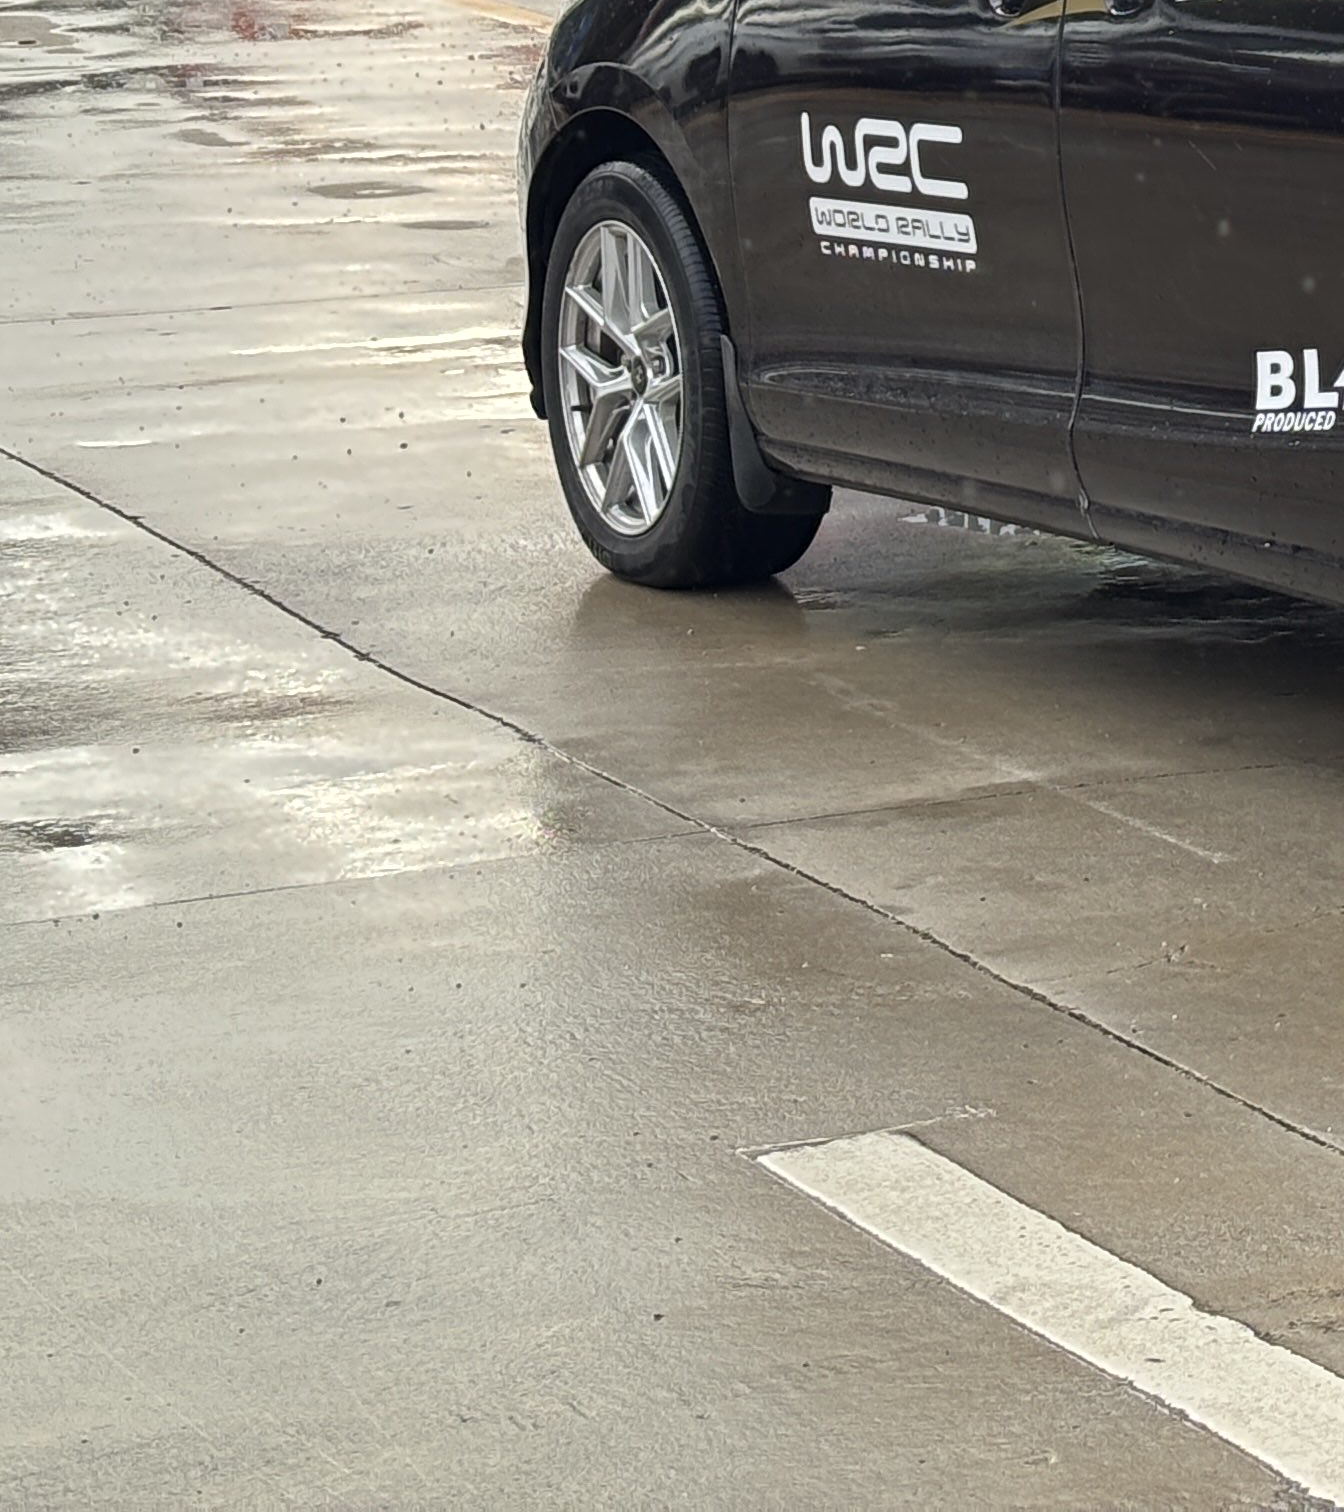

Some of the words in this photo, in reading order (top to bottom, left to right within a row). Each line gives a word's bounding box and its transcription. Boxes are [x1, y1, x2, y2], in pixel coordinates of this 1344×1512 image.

[801, 112, 969, 200] WRC
[815, 207, 890, 233] WORLD
[896, 216, 971, 243] RALLY
[820, 241, 977, 273] CHAMPIONSHIP
[1251, 411, 1337, 433] PRODUCED
